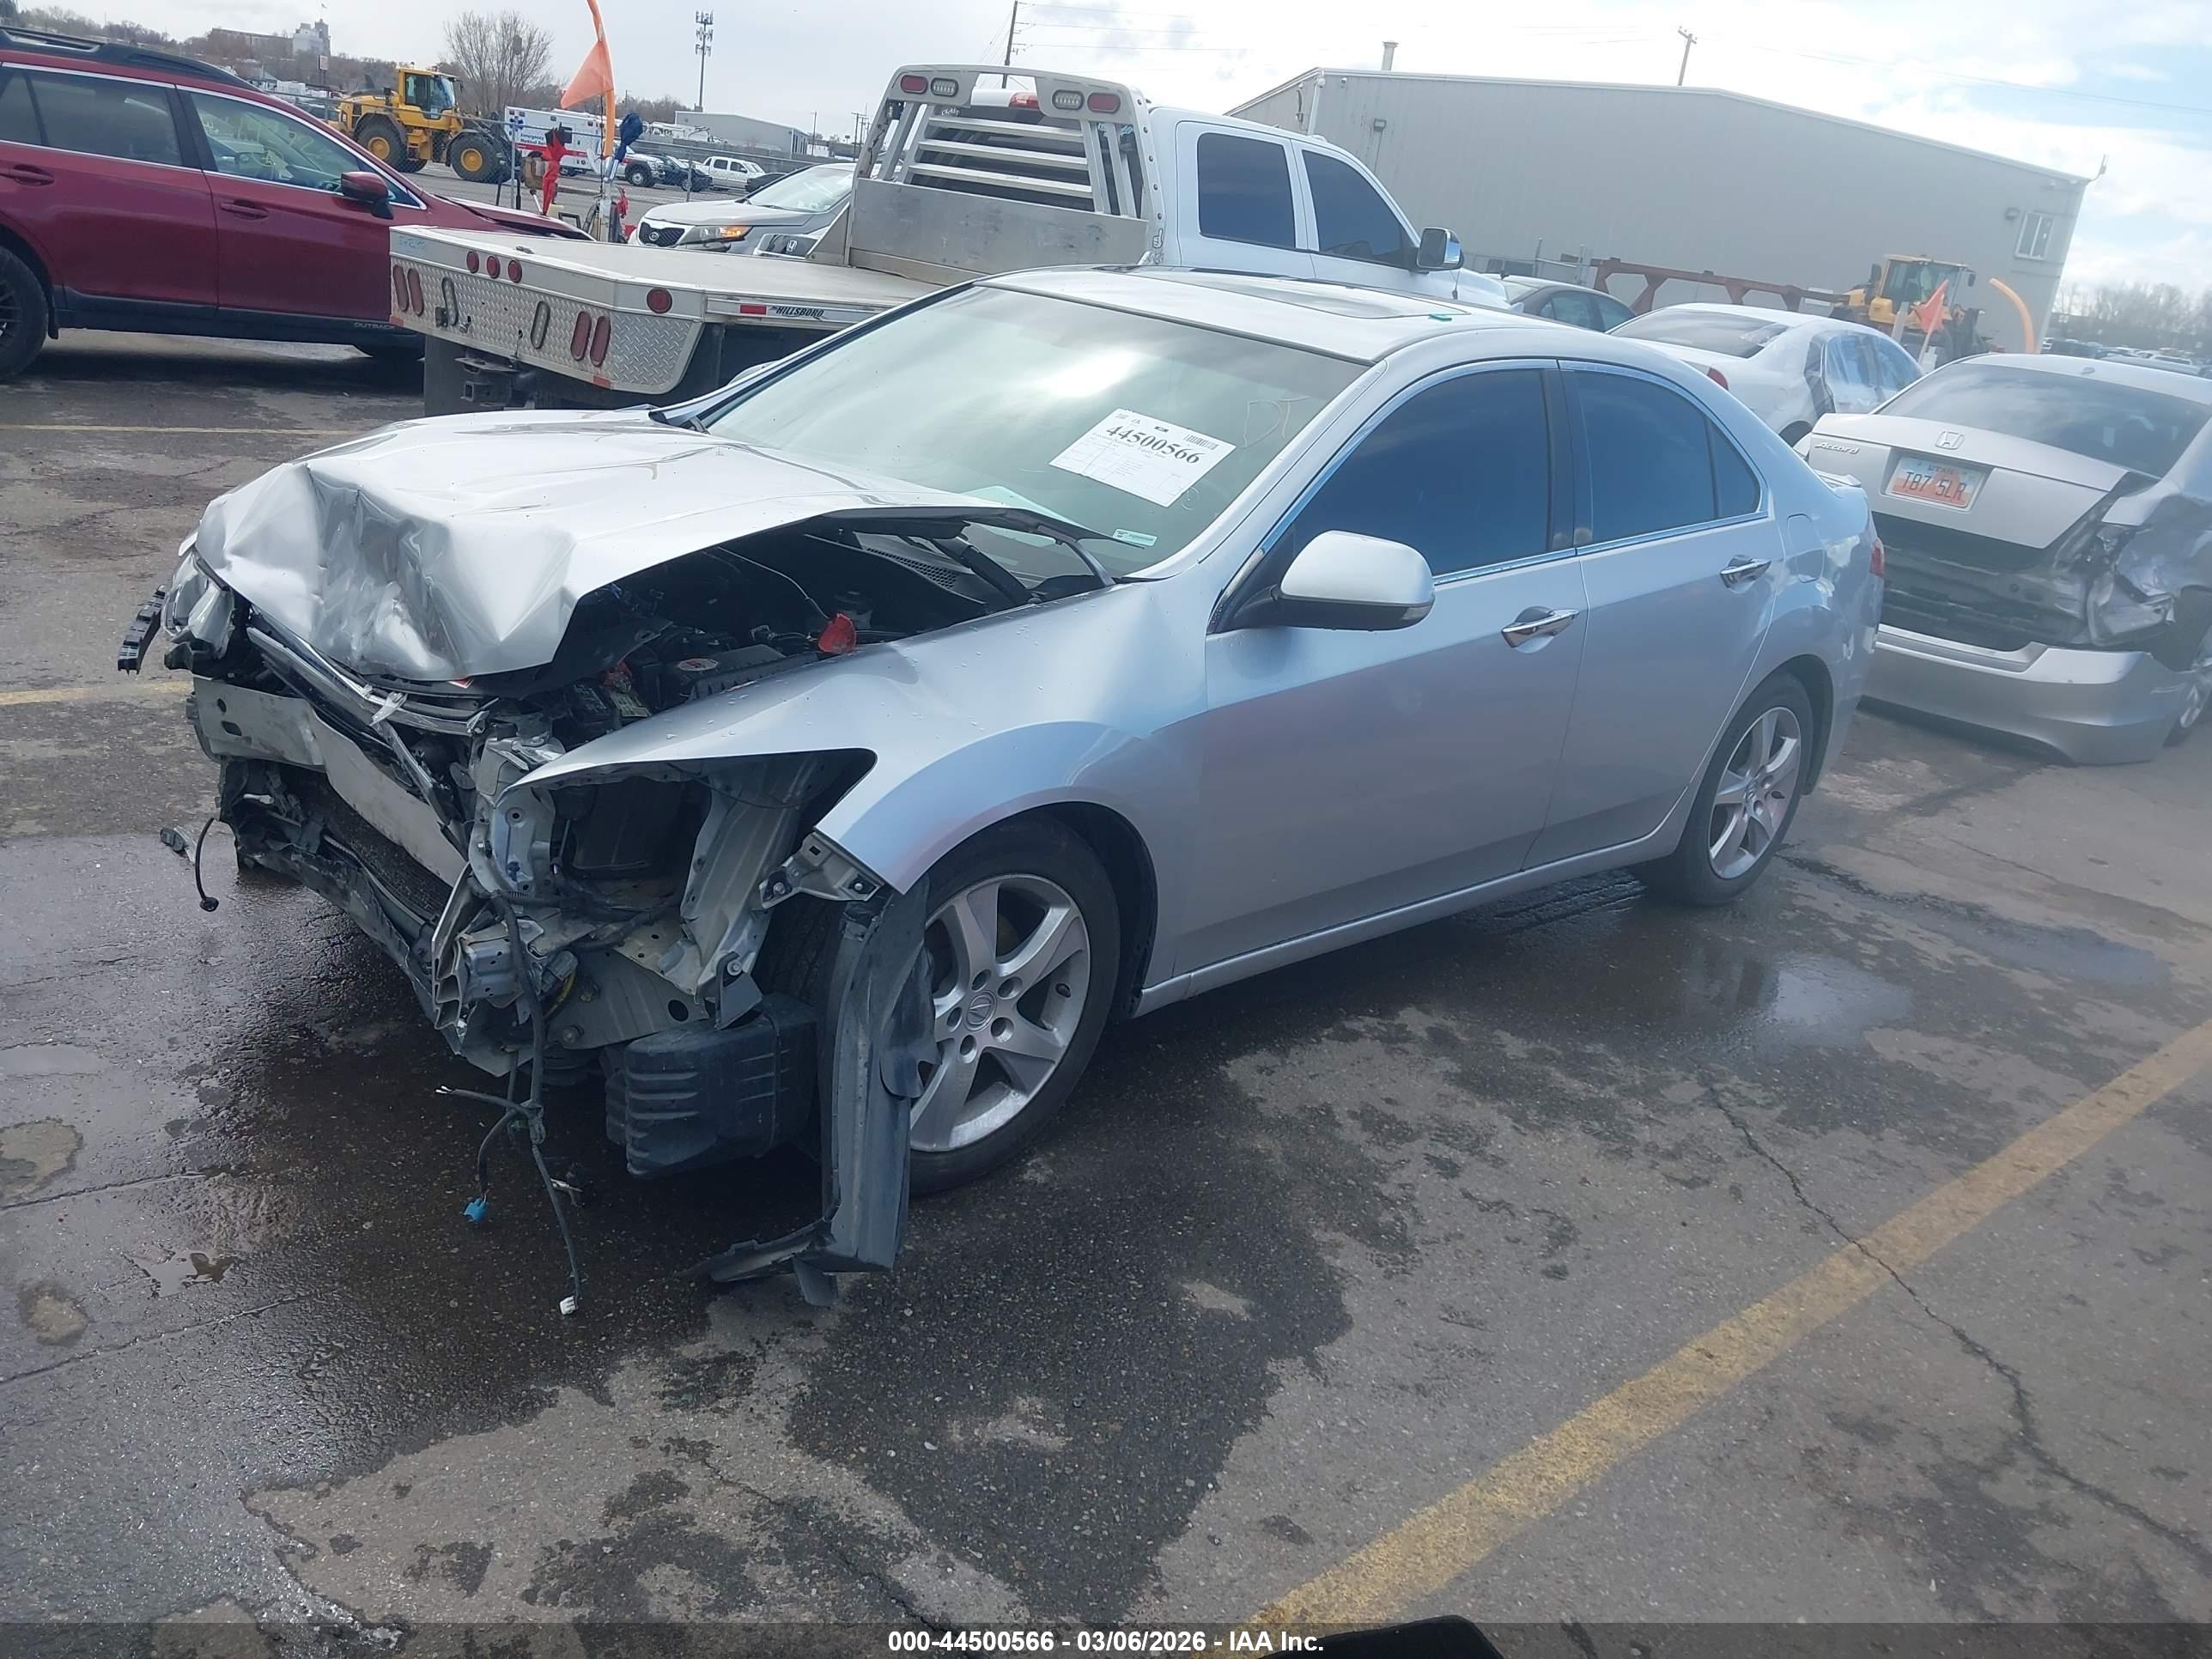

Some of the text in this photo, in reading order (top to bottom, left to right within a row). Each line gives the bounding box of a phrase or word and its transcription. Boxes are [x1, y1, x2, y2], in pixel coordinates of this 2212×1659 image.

[775, 306, 824, 319] HILLSBORO
[1106, 426, 1206, 464] 44500566
[1814, 441, 1860, 454] Accord
